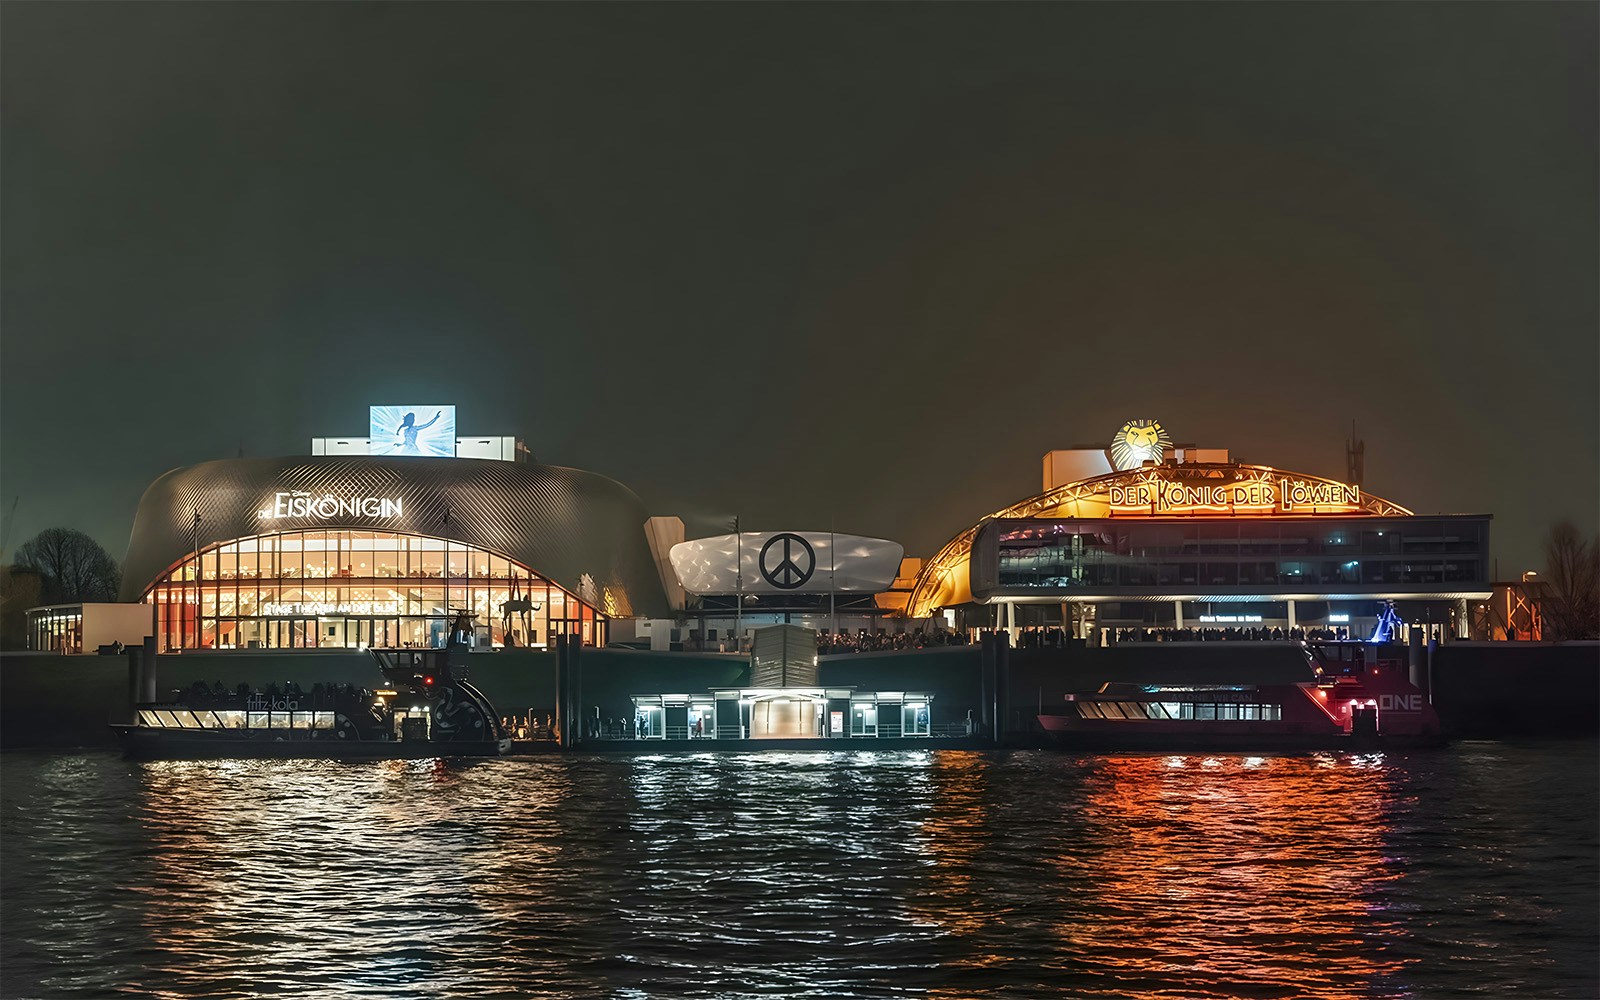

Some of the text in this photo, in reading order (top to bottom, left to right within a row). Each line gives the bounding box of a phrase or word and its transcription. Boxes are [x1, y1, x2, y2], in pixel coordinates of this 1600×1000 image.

[274, 492, 402, 519] EISKÖNIGIN
[1110, 479, 1360, 511] DER KÖNIG DER LÖWEN
[1380, 694, 1422, 710] ONE
